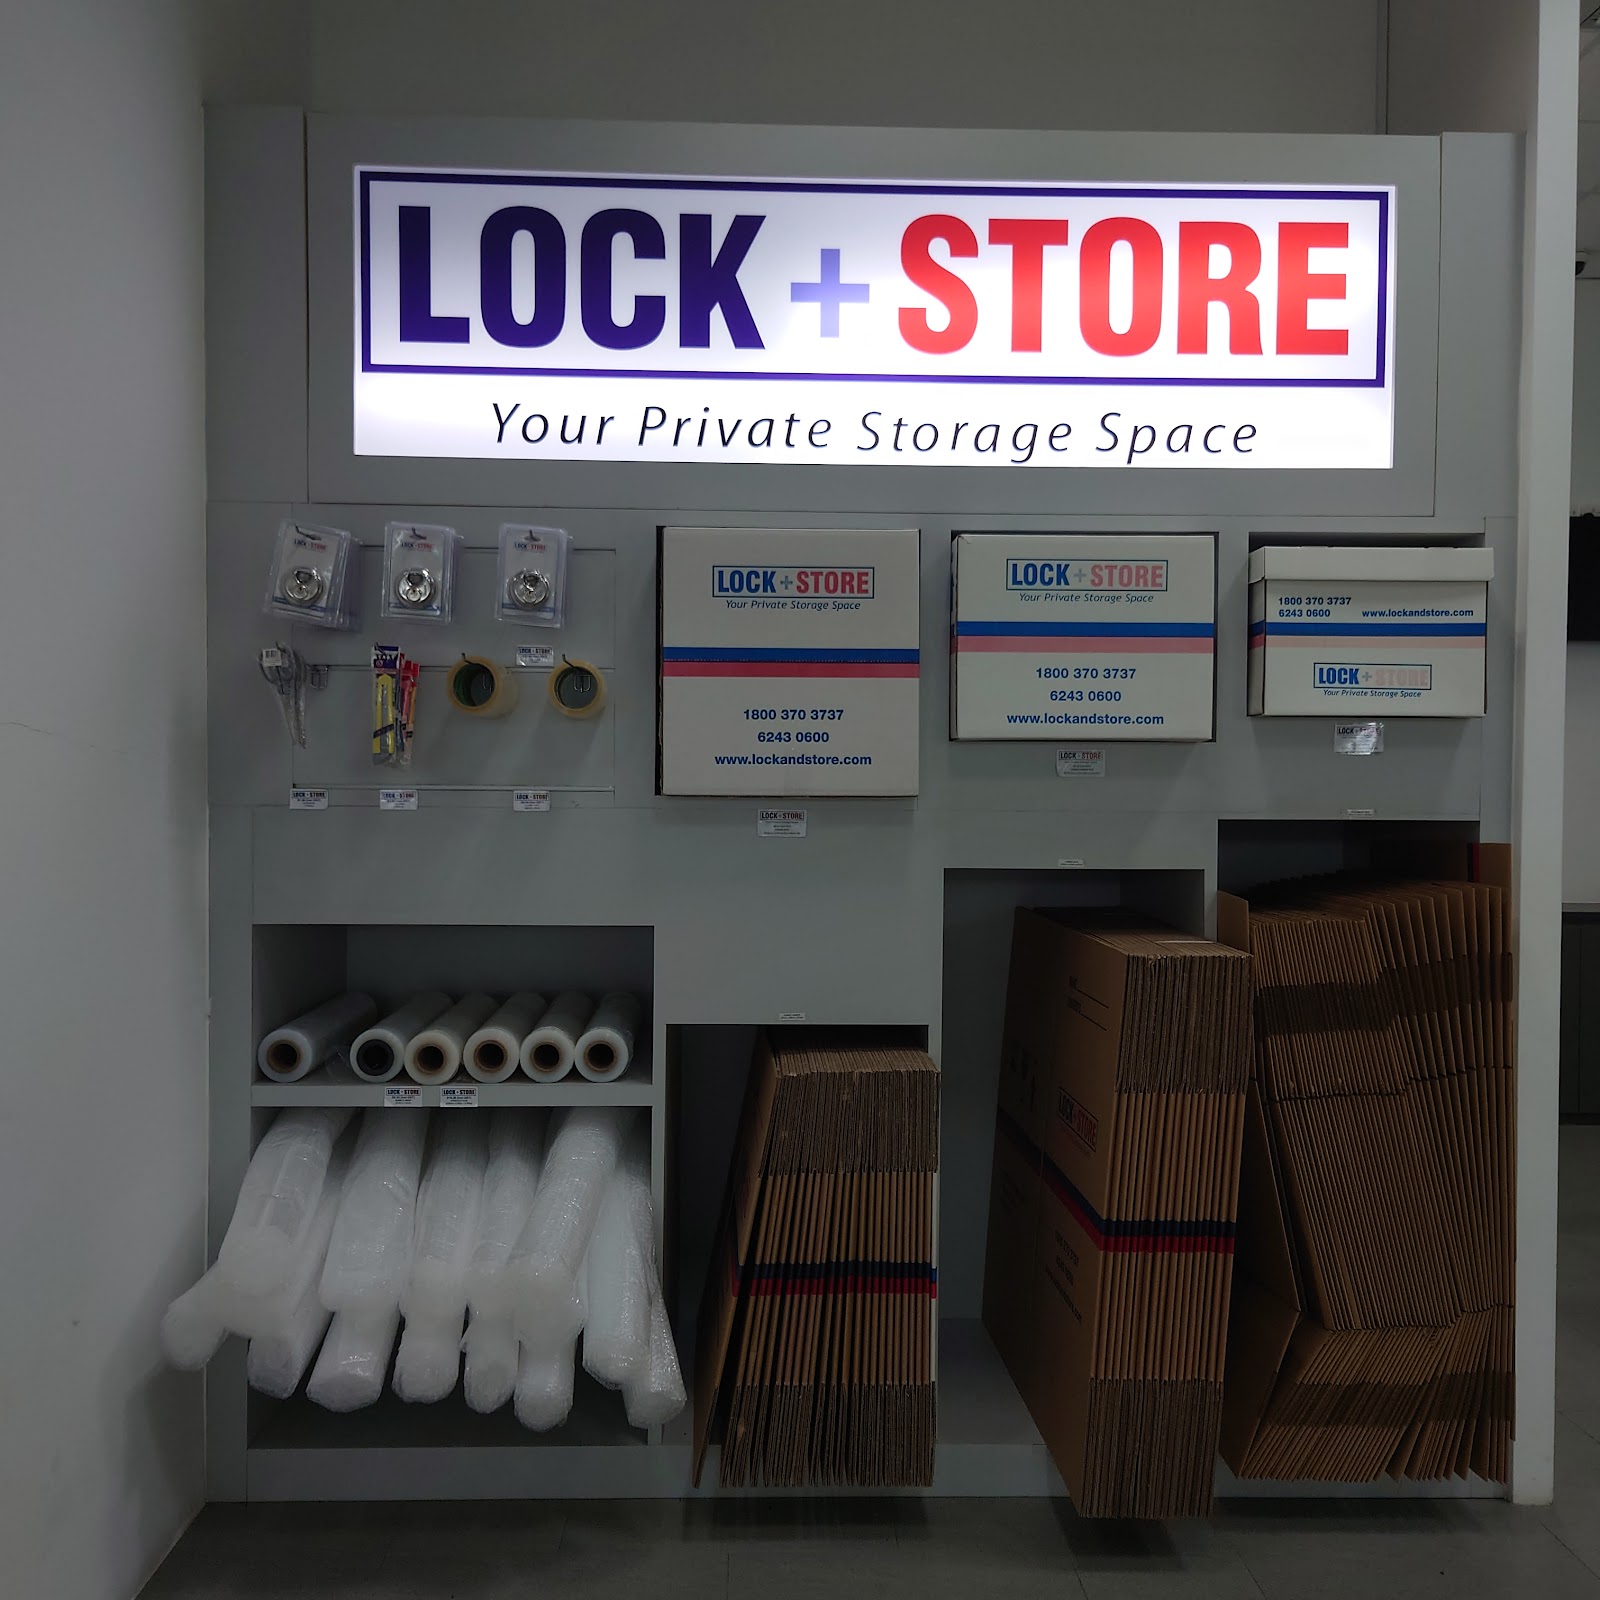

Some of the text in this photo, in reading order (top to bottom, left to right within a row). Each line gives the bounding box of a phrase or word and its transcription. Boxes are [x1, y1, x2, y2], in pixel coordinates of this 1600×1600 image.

[400, 205, 765, 350] LOCK
[898, 214, 1350, 356] STORE
[492, 404, 1257, 467] Your Private Storage Space
[1012, 564, 1069, 586] LOCK
[1090, 565, 1163, 588] STORE
[718, 570, 776, 593] LOCK
[797, 571, 869, 594] STORE
[1019, 594, 1153, 604] Your Private Storage Space
[1279, 597, 1351, 606] 1800 370 3737
[726, 600, 861, 611] Your Private Storage Space
[1279, 608, 1473, 617] 6243 0600 www.lockandstore.com
[1036, 668, 1136, 679] 1800 370 3737
[1319, 668, 1359, 685] LOCK
[1376, 669, 1428, 686] STORE
[1050, 691, 1121, 702] 6243 0600
[1342, 690, 1368, 698] Private
[1370, 690, 1397, 698] Storage
[1400, 690, 1421, 698] Space
[744, 710, 844, 720] 1800 370 3737
[1007, 713, 1164, 725] www.lockandstore.com
[758, 732, 829, 743] 6243 0600
[715, 754, 871, 766] www.lockandstore.com
[1060, 752, 1102, 760] LOCK STORE
[761, 812, 804, 820] LOCK STORE
